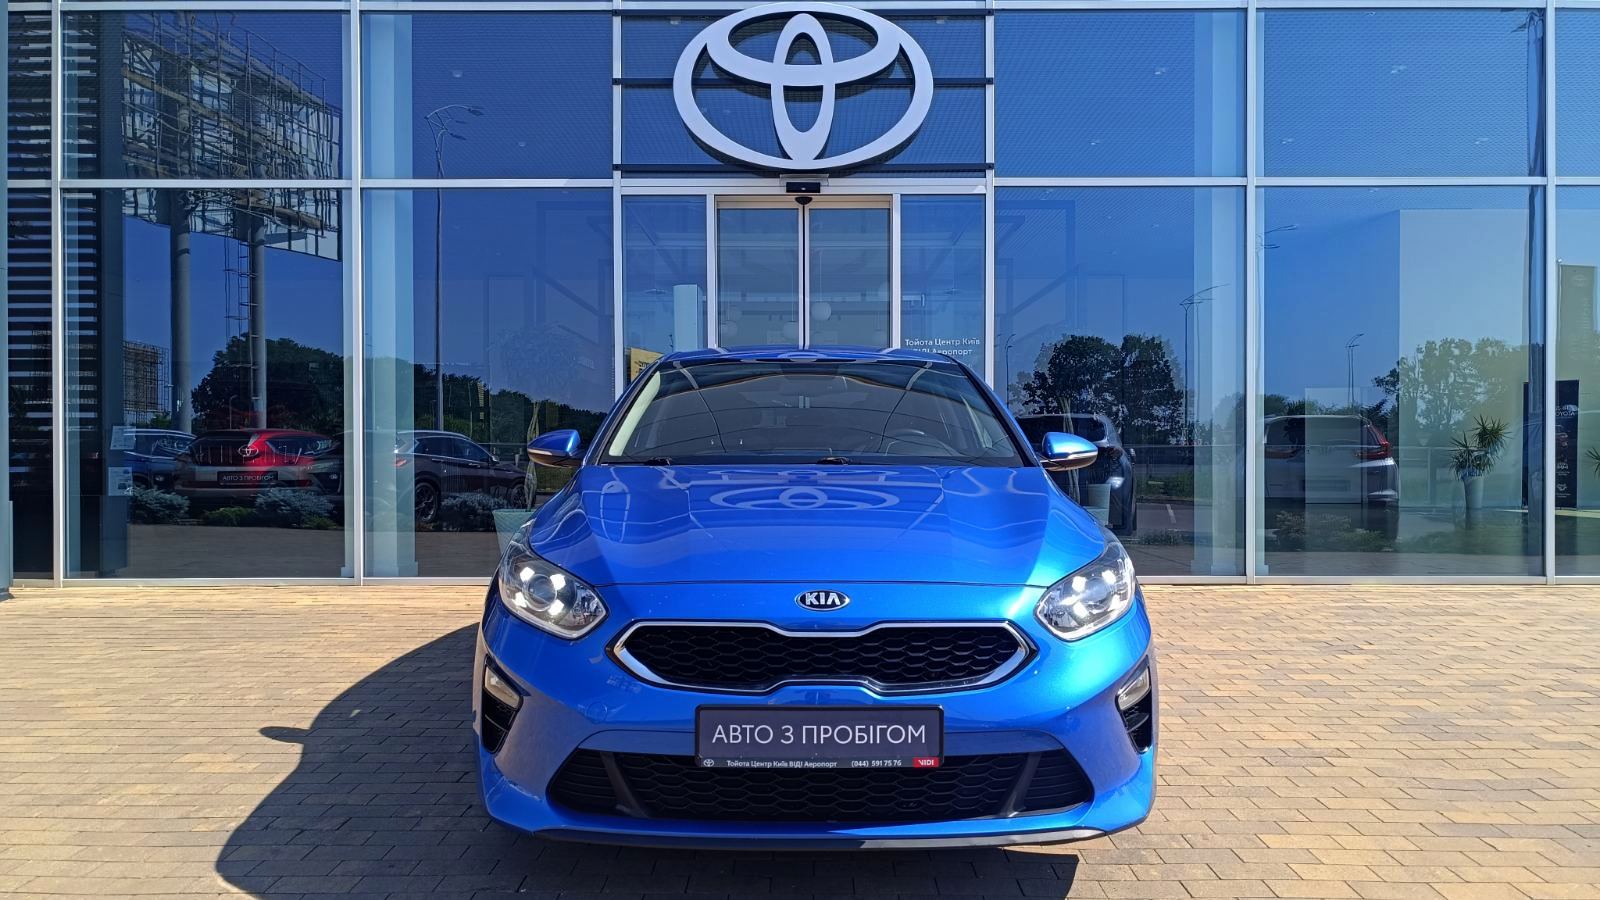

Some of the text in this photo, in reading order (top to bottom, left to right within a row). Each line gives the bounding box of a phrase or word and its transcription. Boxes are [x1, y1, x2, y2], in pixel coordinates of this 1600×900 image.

[905, 337, 980, 347] Тойота Центр Київ
[805, 592, 841, 605] KIA
[712, 724, 774, 744] АВТО
[802, 724, 926, 744] ПРОБІГОМ
